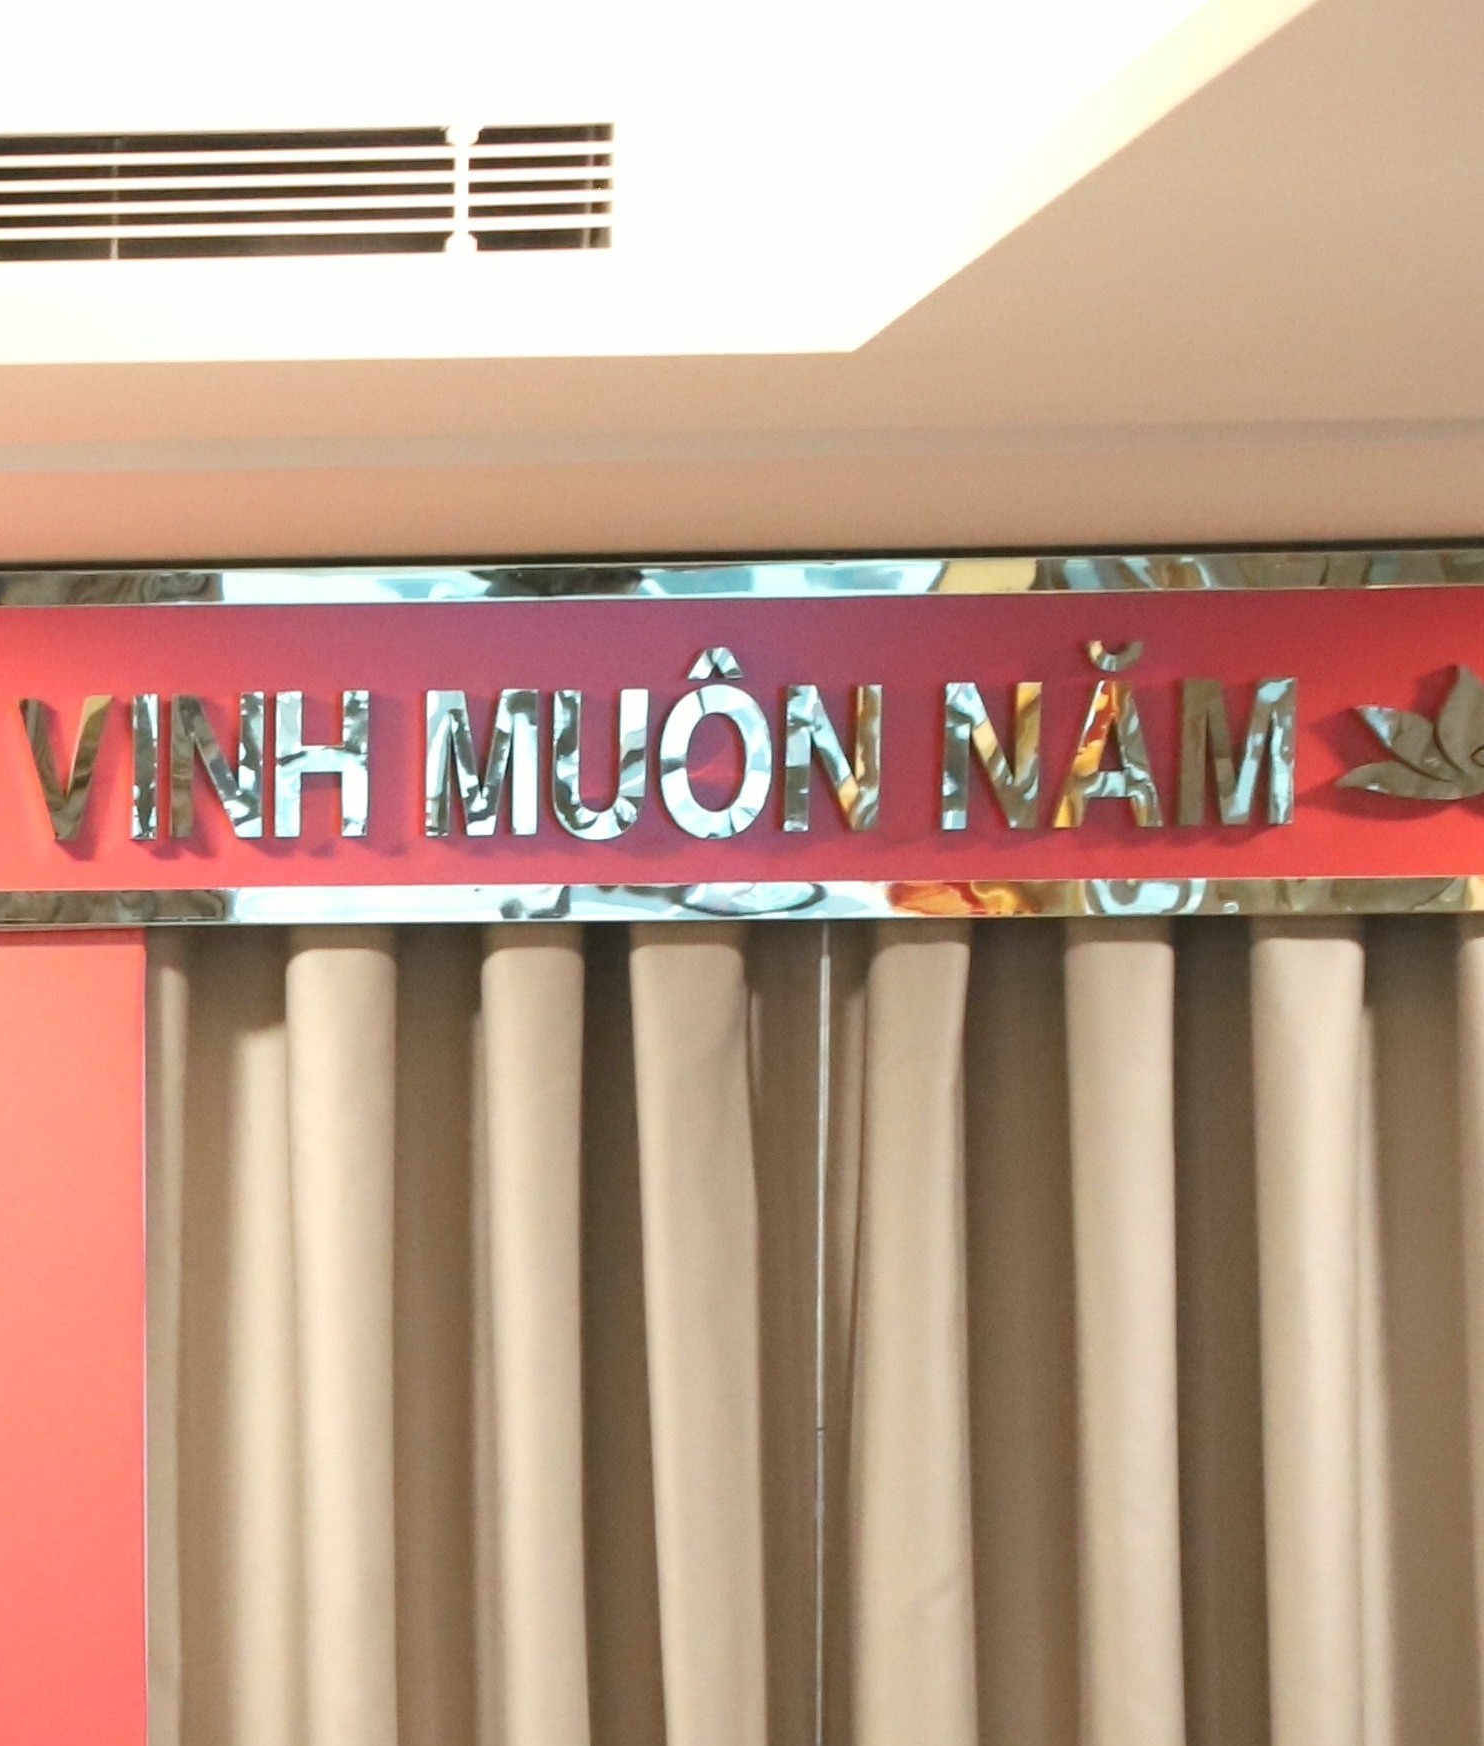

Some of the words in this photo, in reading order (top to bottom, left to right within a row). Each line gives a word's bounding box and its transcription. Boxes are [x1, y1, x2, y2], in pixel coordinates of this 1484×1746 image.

[19, 690, 370, 841] VINH
[424, 647, 882, 840] MUÔN
[942, 639, 1297, 830] NĂM
